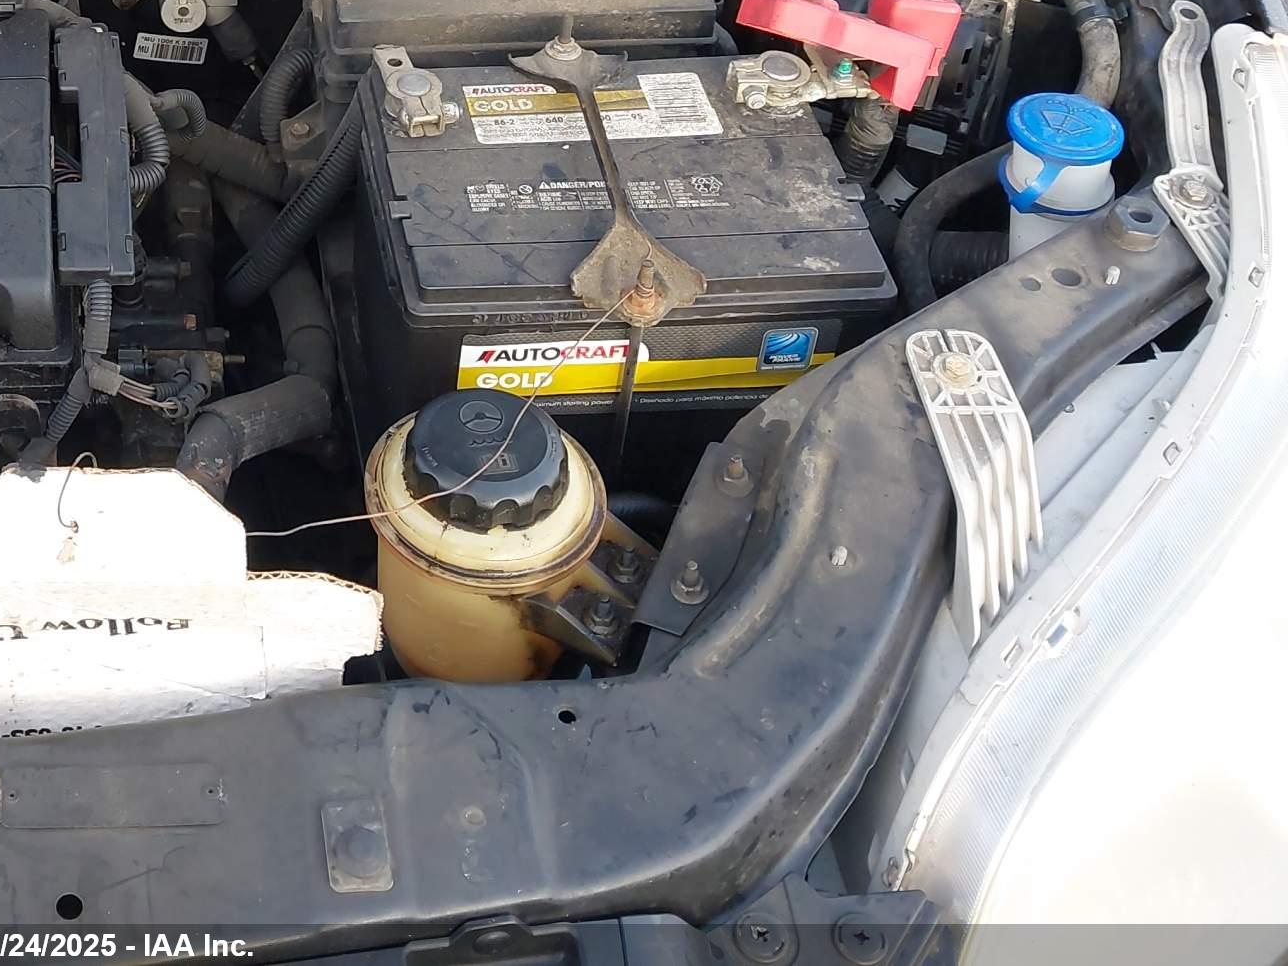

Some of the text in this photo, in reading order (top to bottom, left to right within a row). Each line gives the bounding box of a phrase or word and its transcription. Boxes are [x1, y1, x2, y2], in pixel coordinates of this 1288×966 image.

[479, 85, 546, 94] AUTOCRAFT
[474, 98, 533, 113] GOLD
[545, 116, 564, 124] 640
[493, 344, 630, 362] AUTOCRAFT
[476, 372, 553, 389] GOLD
[41, 617, 191, 636] Follow
